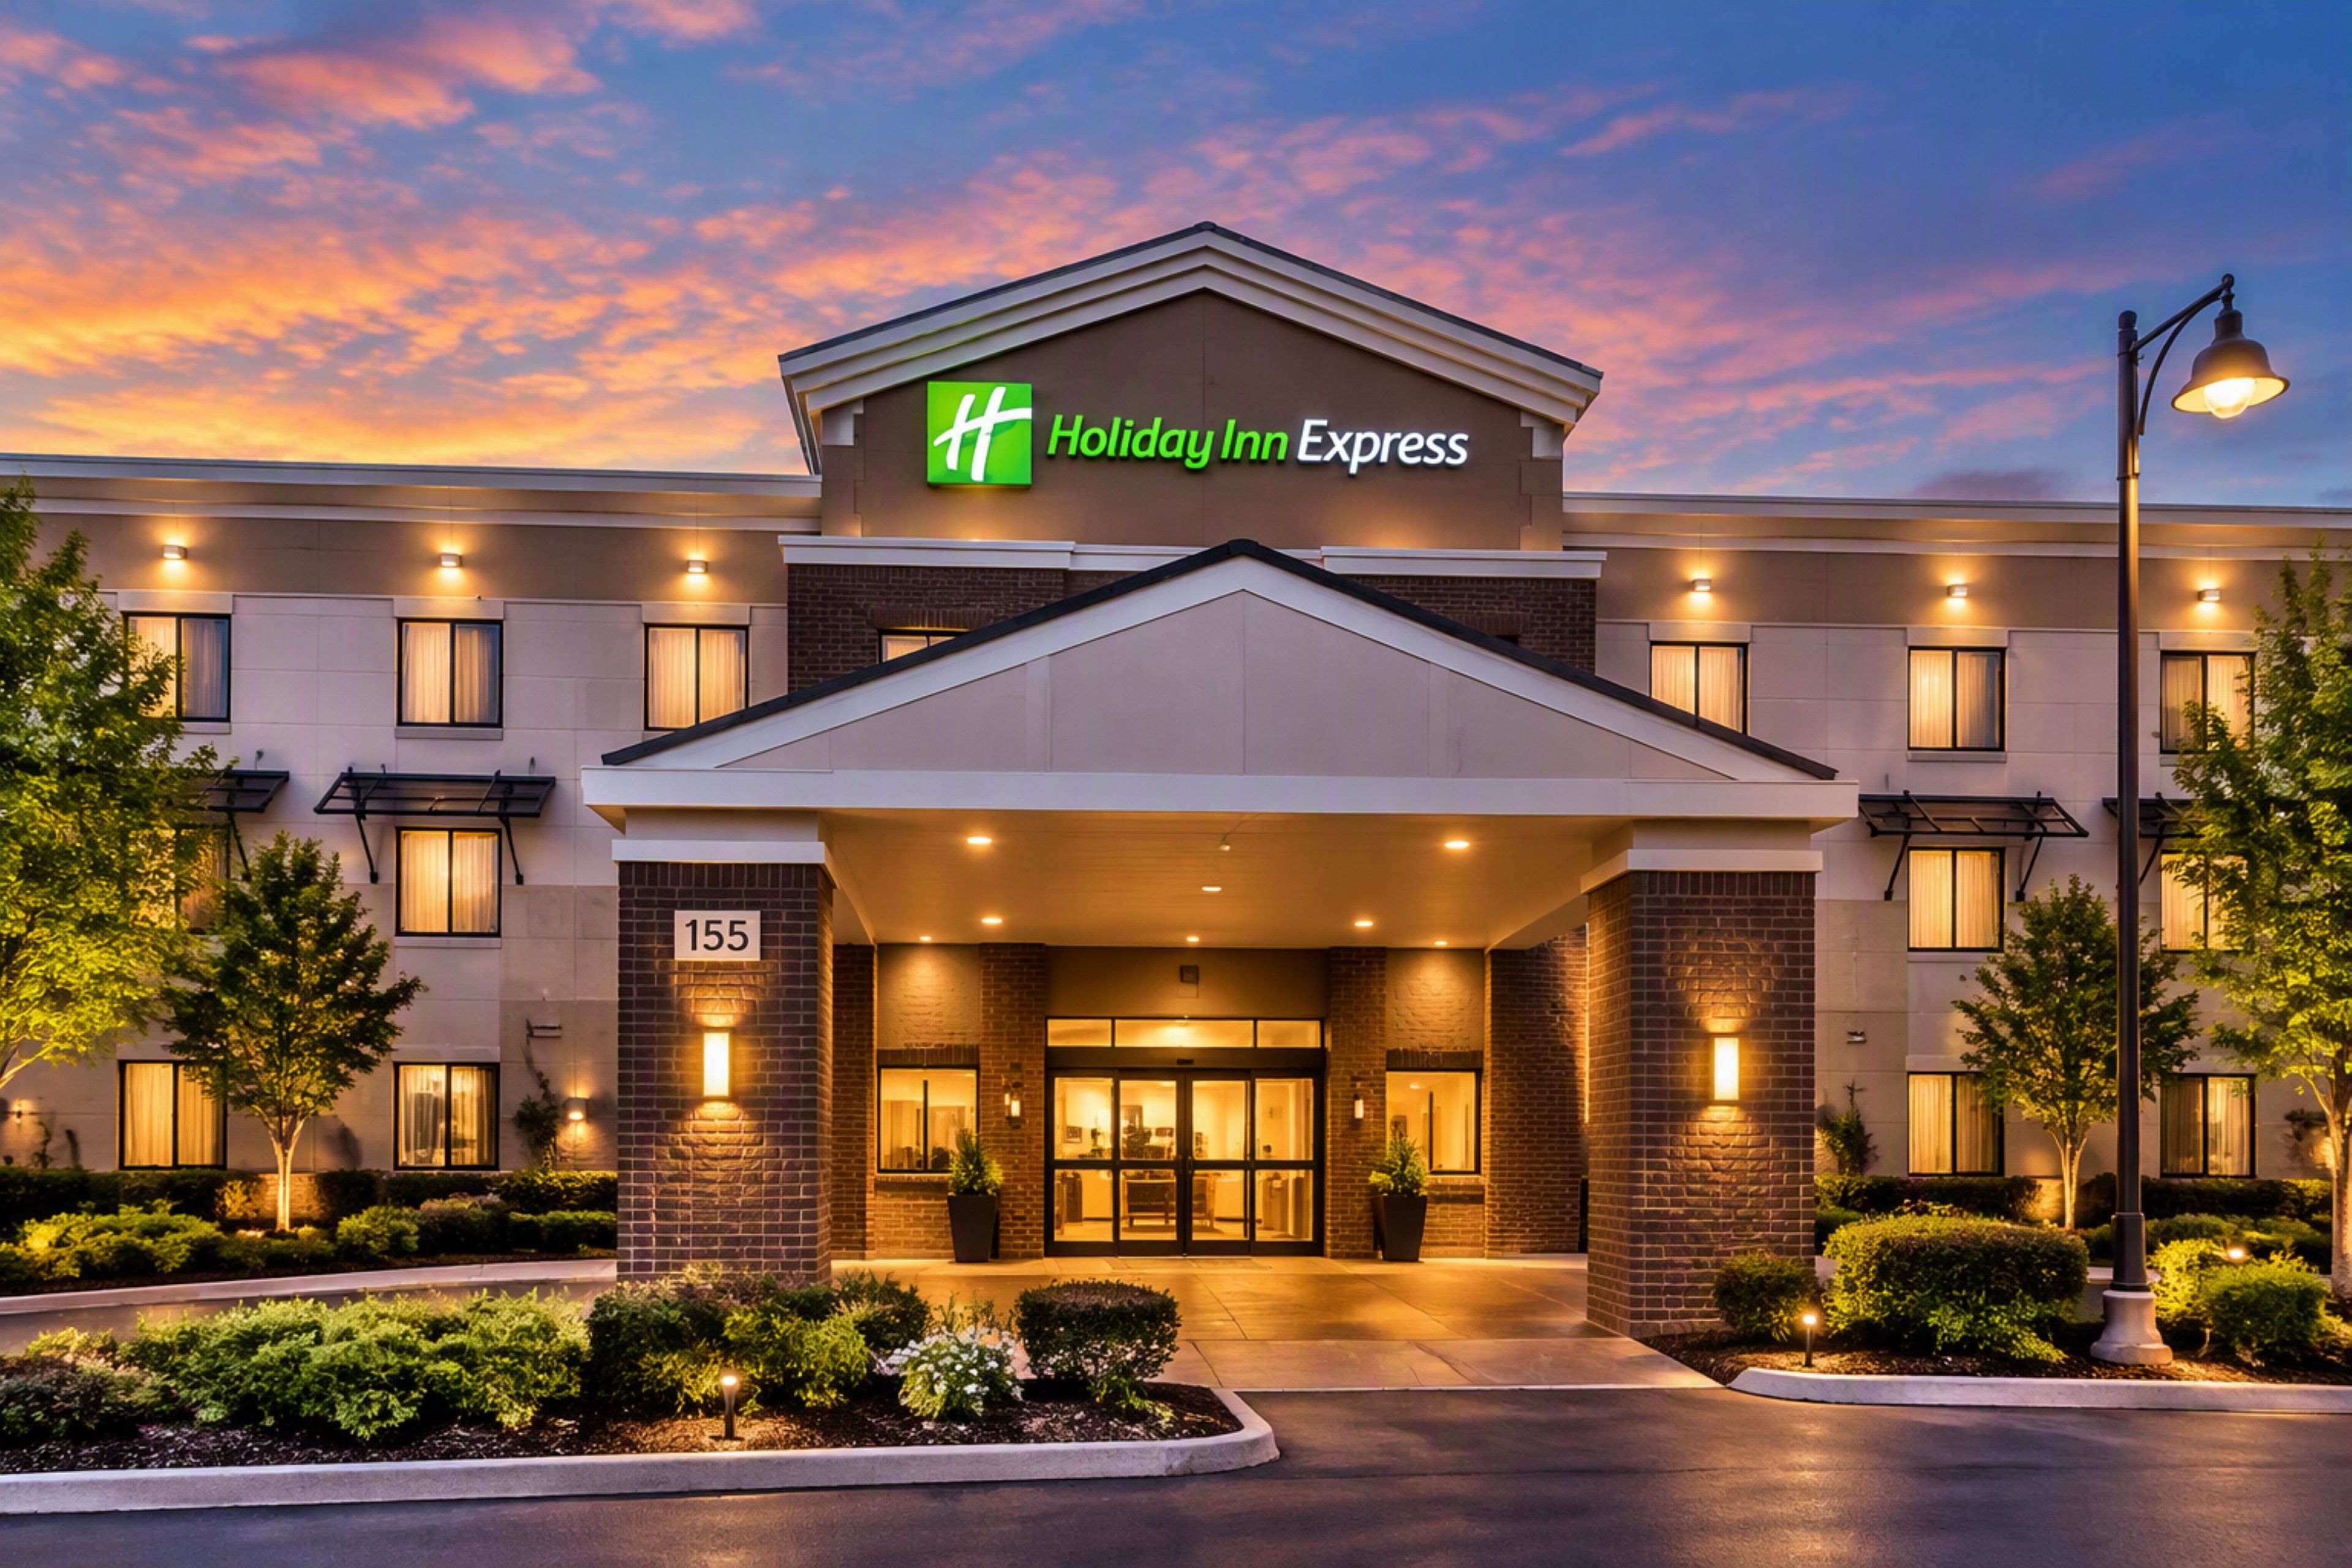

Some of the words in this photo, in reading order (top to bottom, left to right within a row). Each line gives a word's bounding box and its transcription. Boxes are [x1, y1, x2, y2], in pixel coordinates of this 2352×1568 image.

[933, 386, 1032, 482] H
[1047, 414, 1215, 469] Holiday
[1221, 418, 1289, 460] Inn
[1297, 419, 1469, 475] Express
[685, 919, 748, 951] 155
